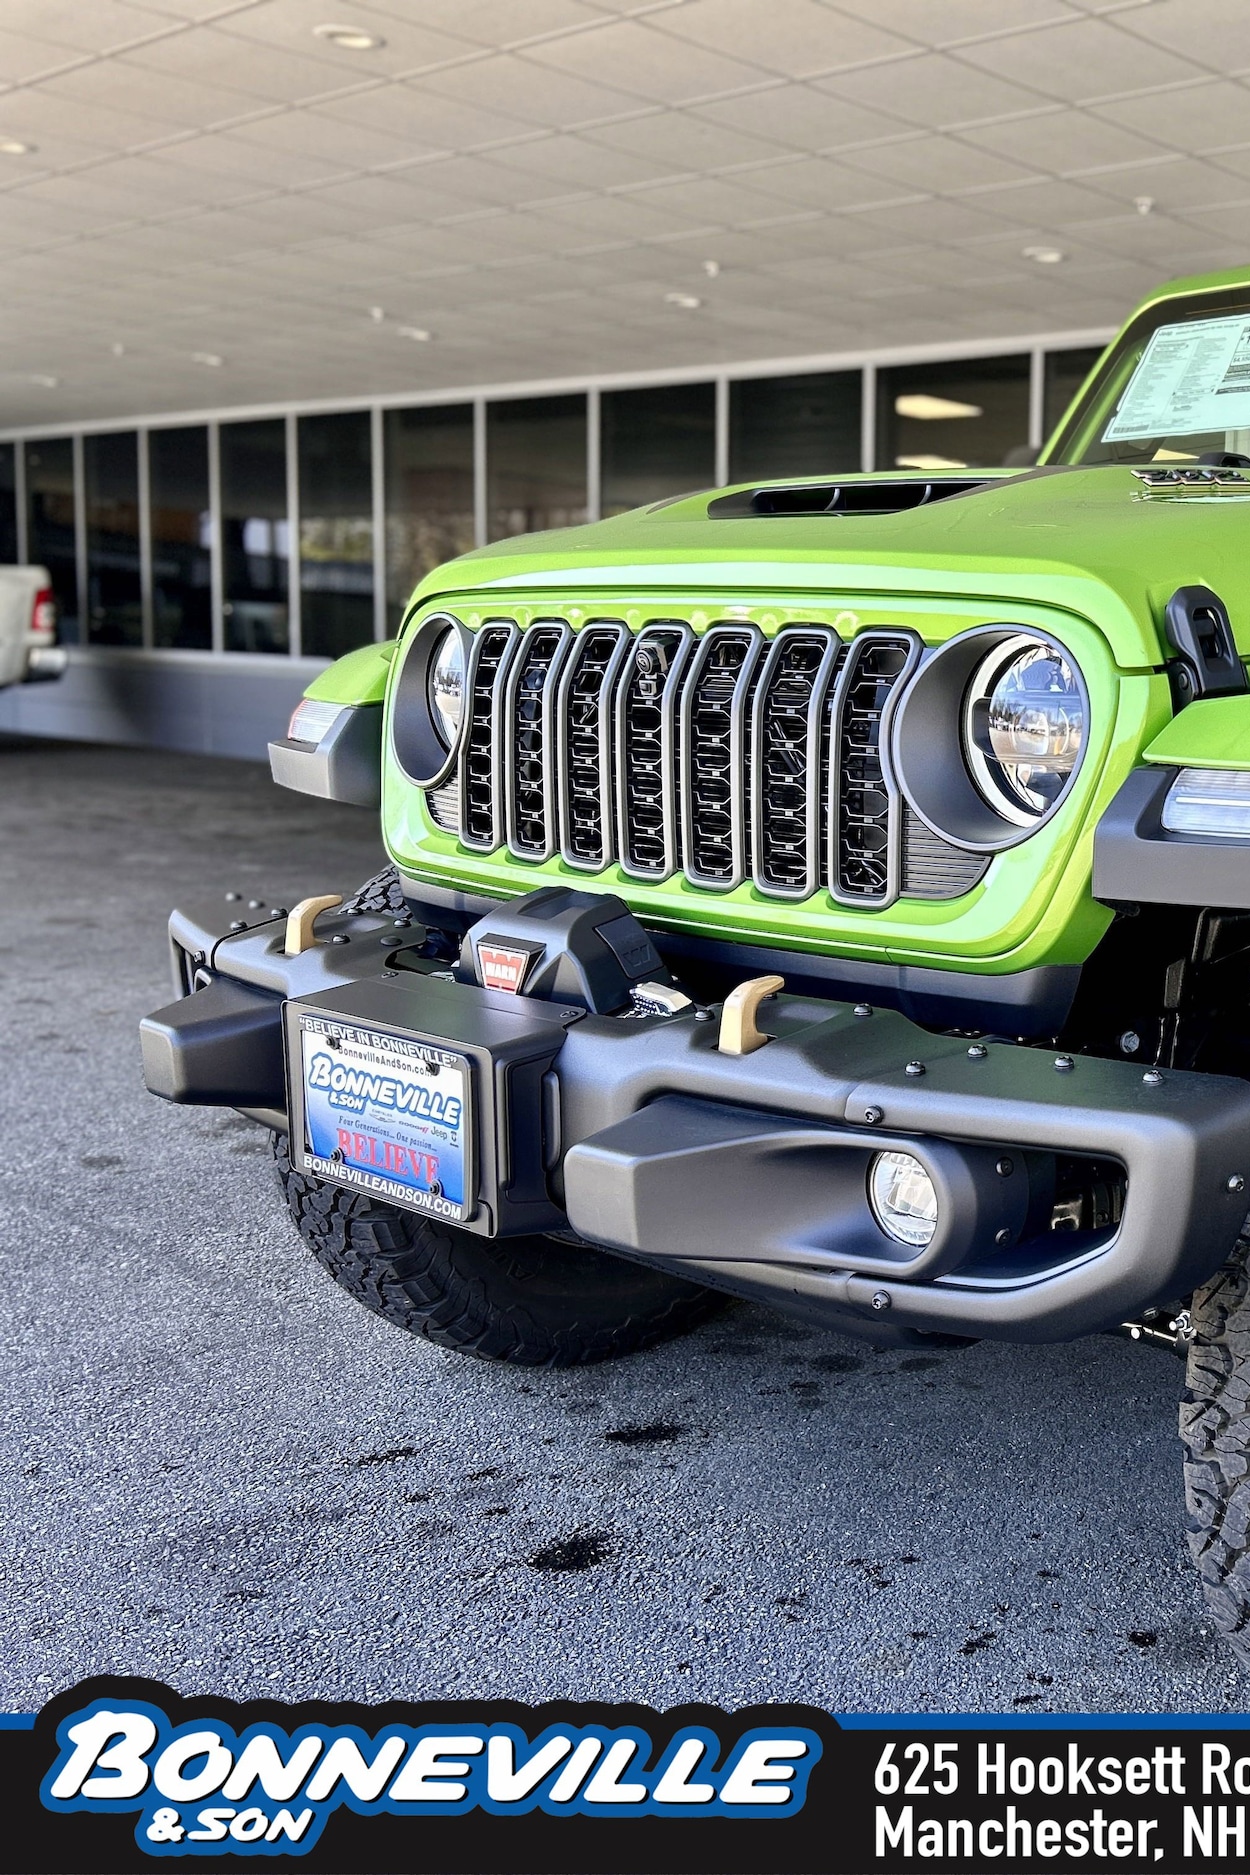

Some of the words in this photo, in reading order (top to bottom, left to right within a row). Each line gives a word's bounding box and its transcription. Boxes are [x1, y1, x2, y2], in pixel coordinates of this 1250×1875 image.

[485, 961, 517, 982] WARN
[357, 1031, 370, 1045] IN
[338, 1047, 432, 1077] BonnevilleAndSon.co
[311, 1056, 460, 1126] BONNEVILLE
[338, 1115, 354, 1127] Four
[396, 1131, 409, 1143] One
[430, 1125, 448, 1141] Jeep
[336, 1128, 440, 1185] BELIEVE
[303, 1155, 462, 1220] BONNEVILLEANDSON.COM
